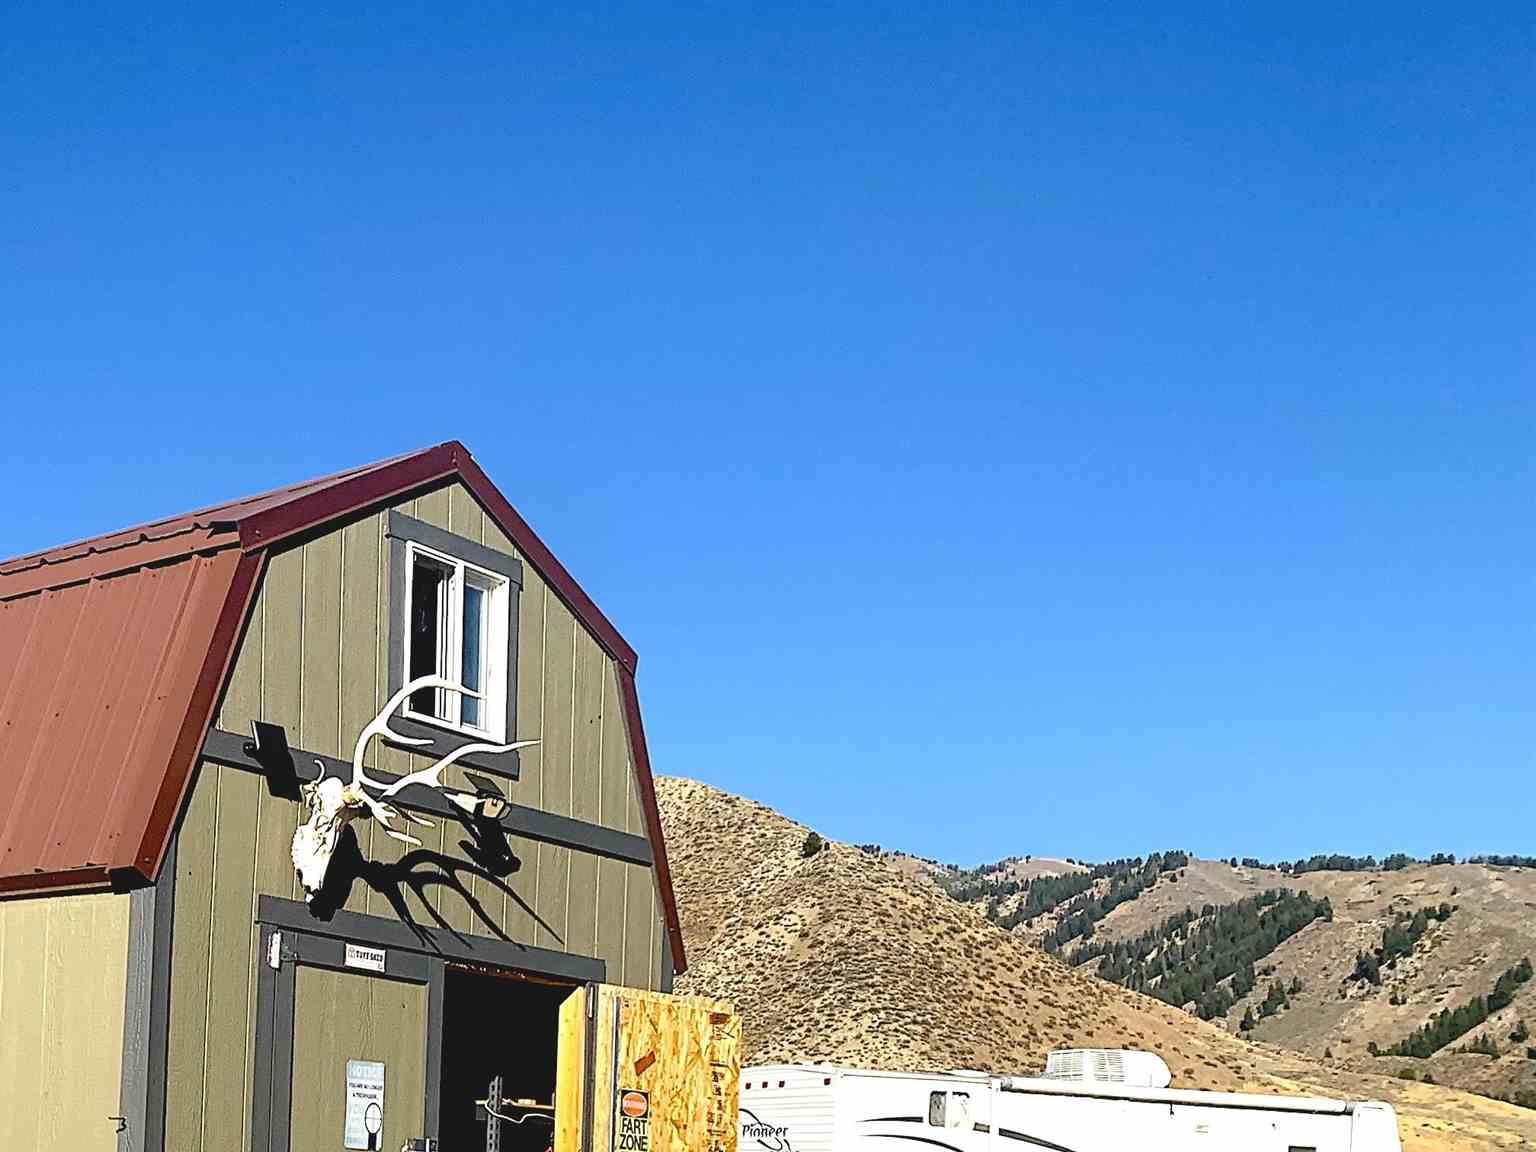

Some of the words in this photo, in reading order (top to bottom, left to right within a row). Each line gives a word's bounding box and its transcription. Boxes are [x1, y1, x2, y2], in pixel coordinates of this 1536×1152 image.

[622, 1117, 648, 1135] FART
[742, 1123, 789, 1138] Pioneer
[619, 1134, 648, 1152] ZONE
